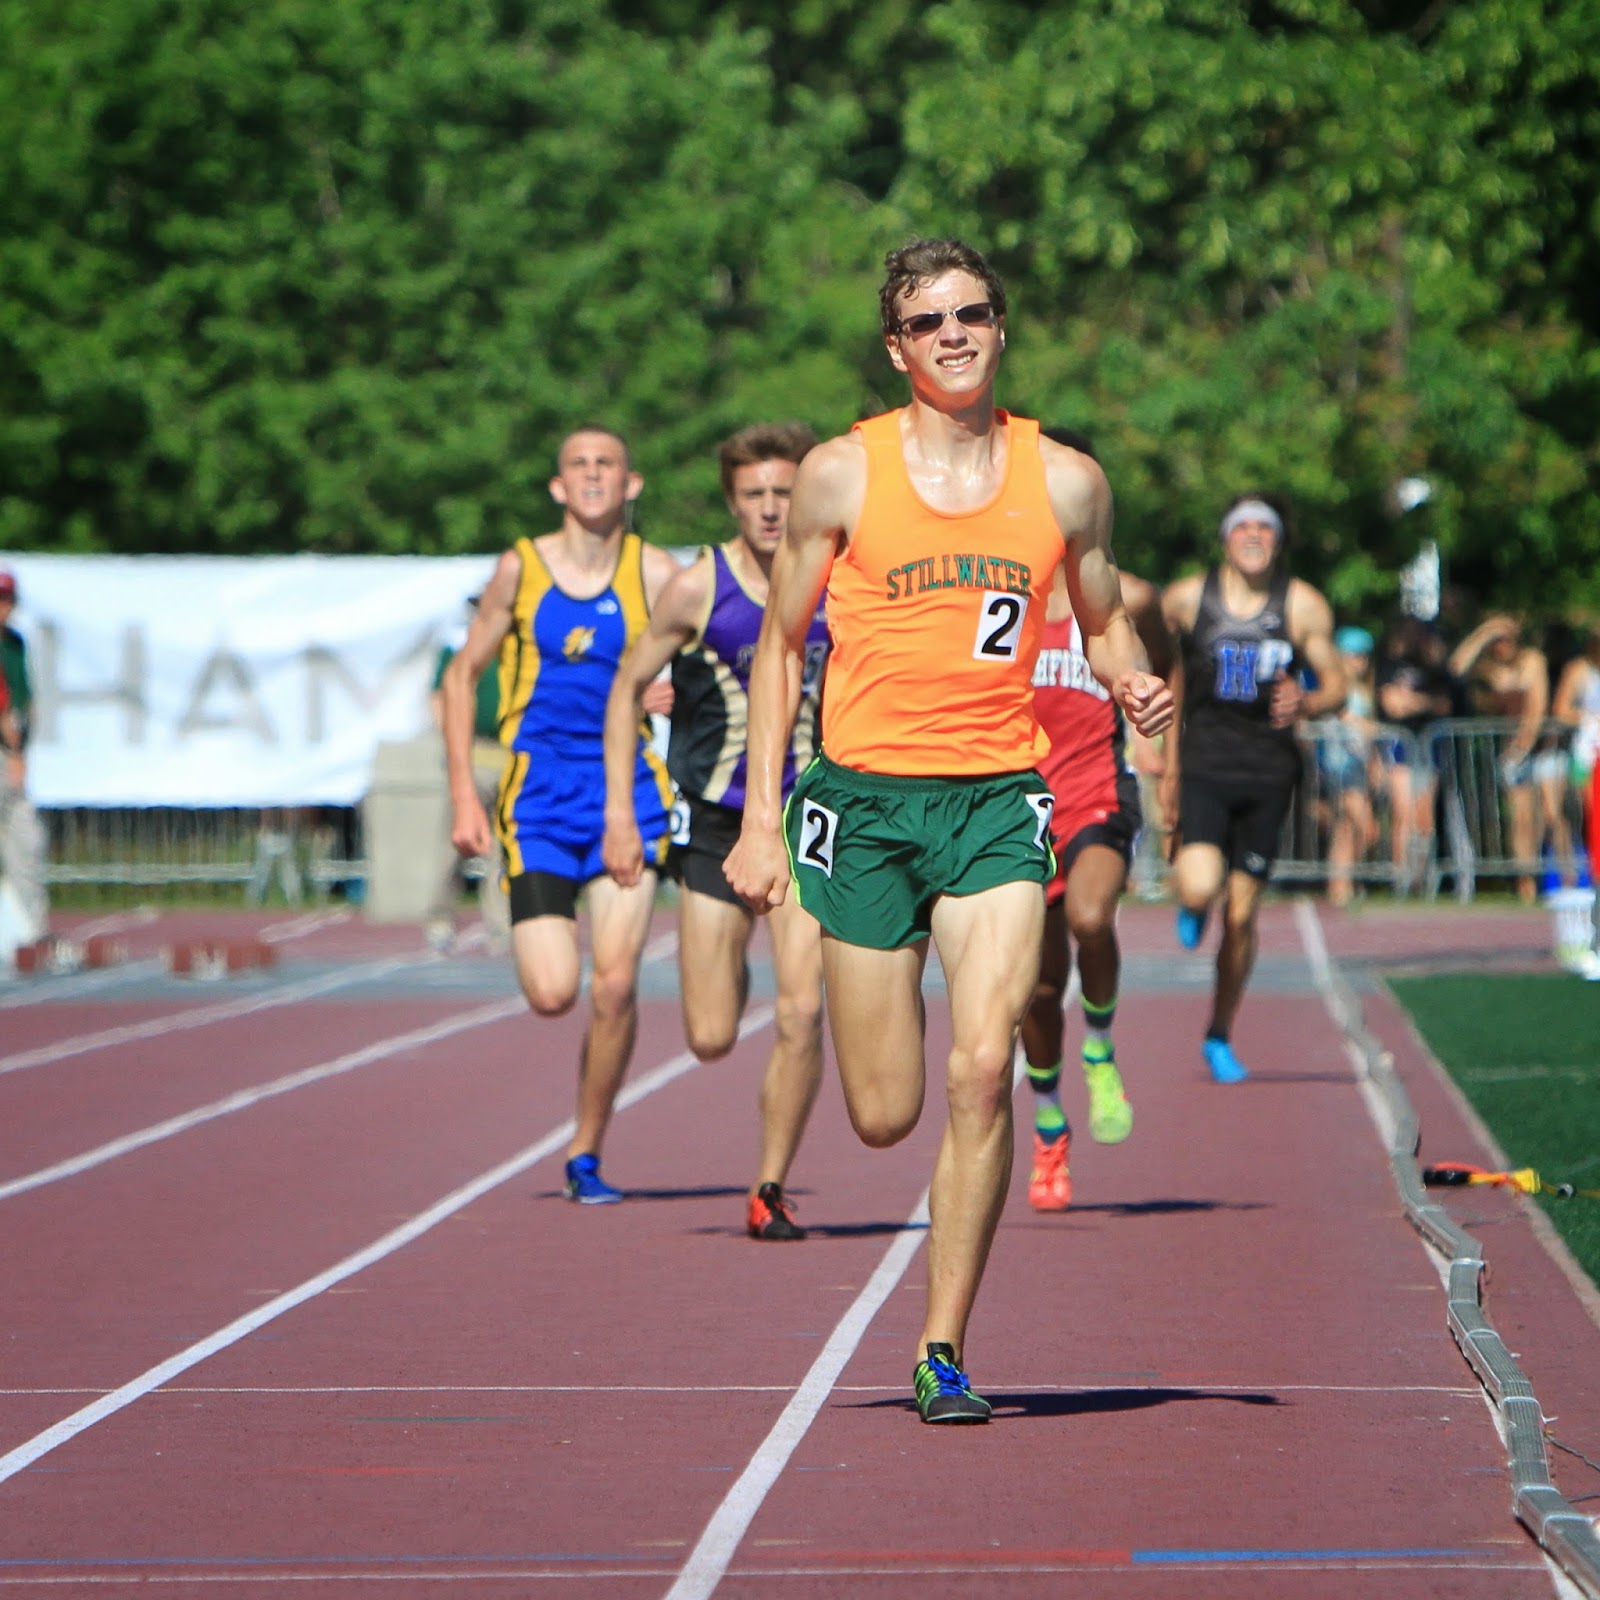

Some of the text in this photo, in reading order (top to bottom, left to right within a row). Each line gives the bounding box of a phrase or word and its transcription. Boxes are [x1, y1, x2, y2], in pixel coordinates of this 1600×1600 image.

[887, 554, 1032, 601] STILLWATER
[981, 597, 1020, 656] 2
[807, 808, 829, 869] 2
